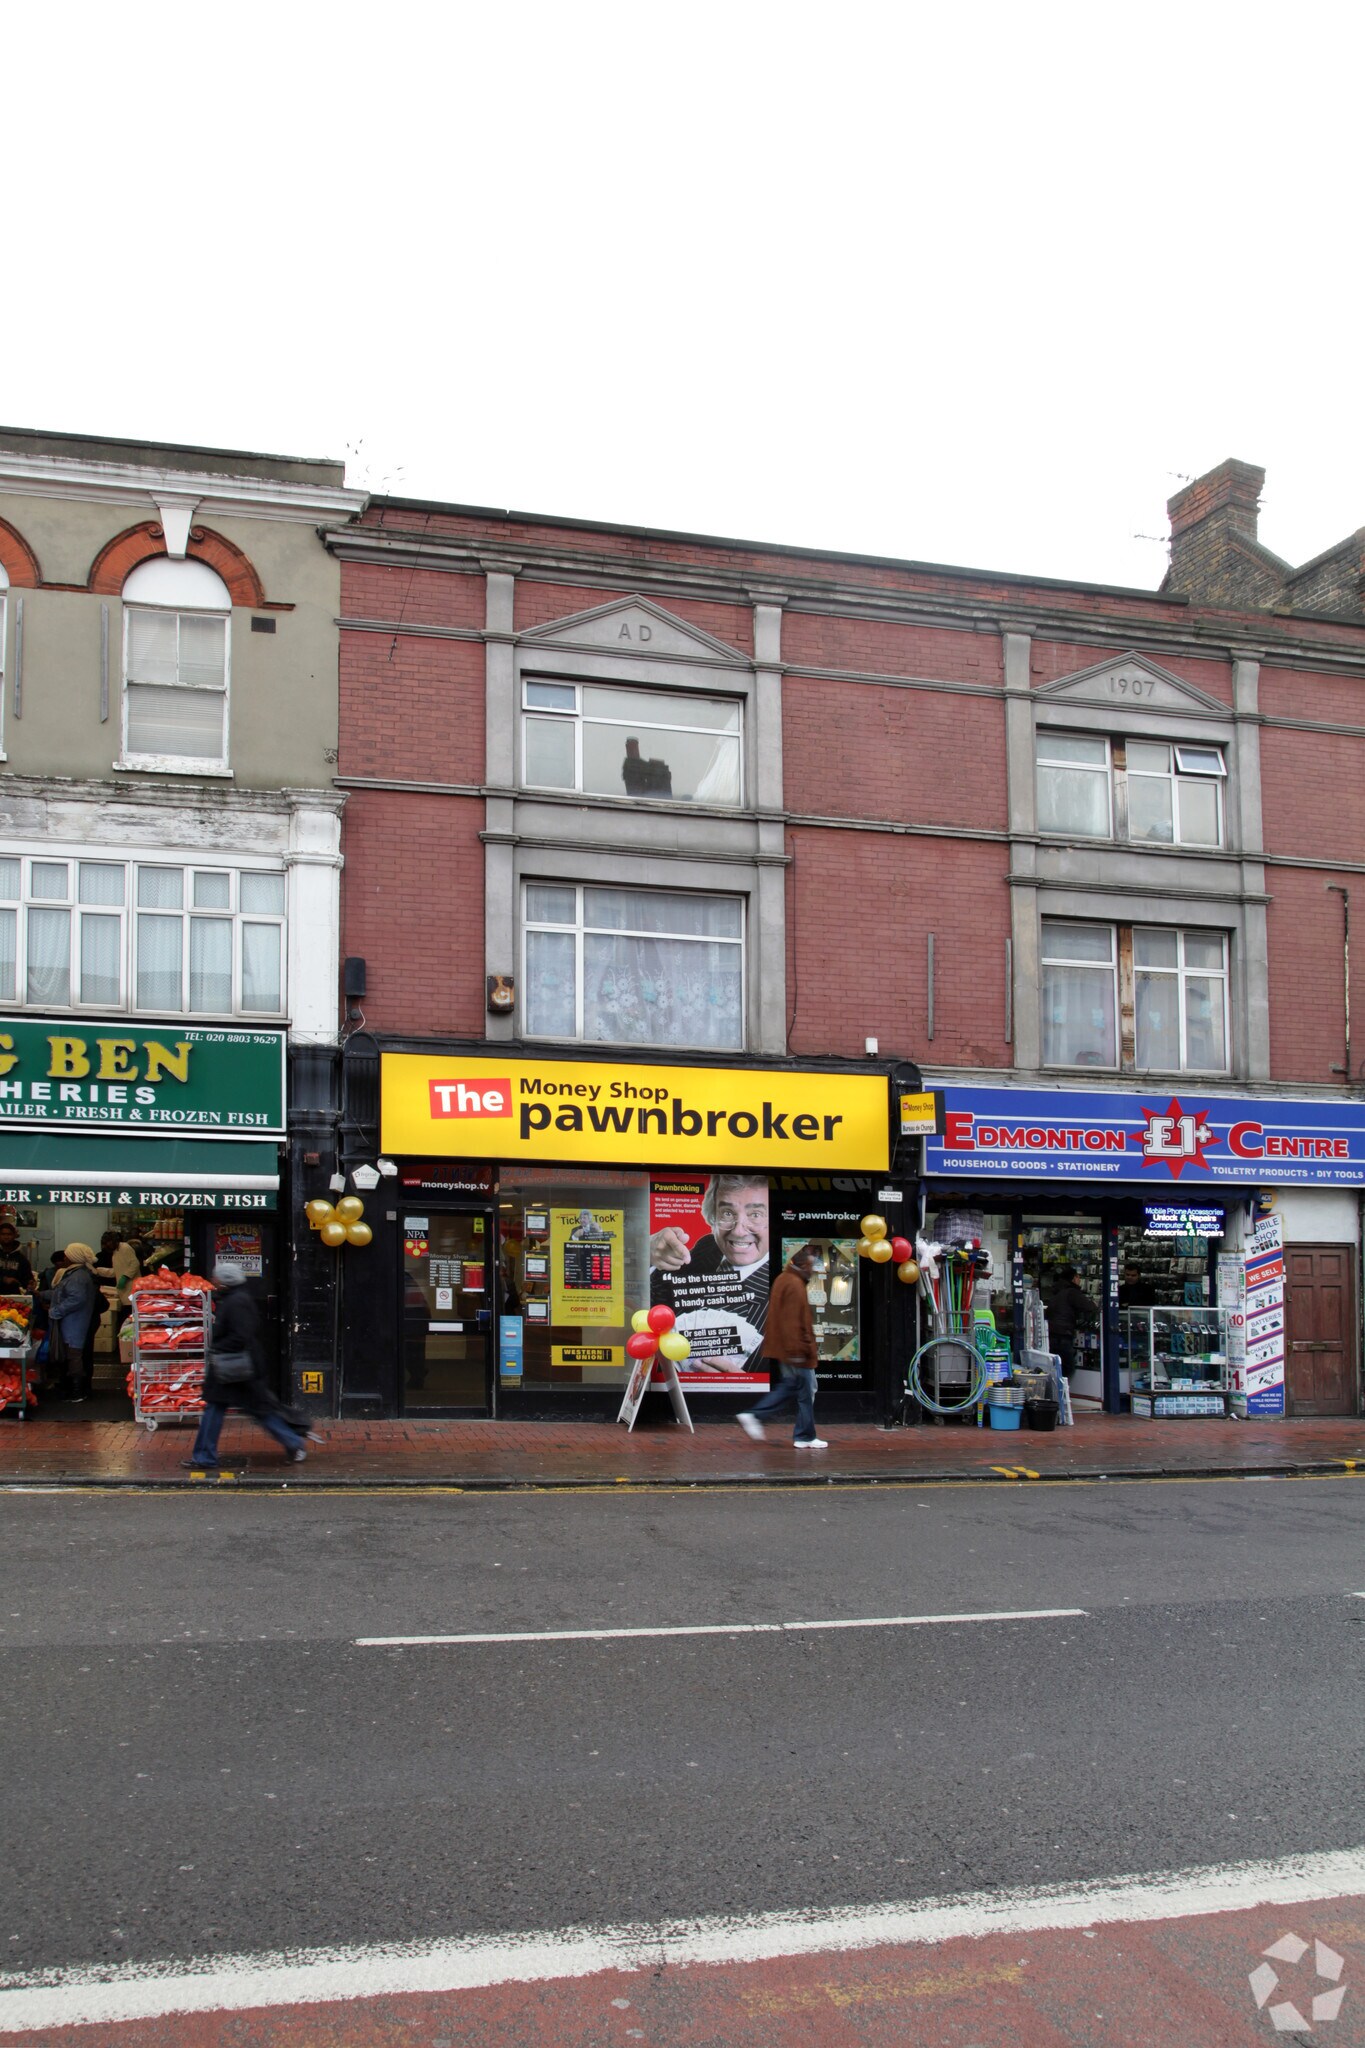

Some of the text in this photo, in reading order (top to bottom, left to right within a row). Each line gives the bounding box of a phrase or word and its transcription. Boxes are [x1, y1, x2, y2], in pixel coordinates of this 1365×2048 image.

[1110, 677, 1155, 696] 1907
[185, 1032, 277, 1044] TEL: 020 8803 9629
[46, 1036, 193, 1082] BEN
[434, 1083, 504, 1112] The
[520, 1078, 669, 1104] Money Shop
[65, 1106, 123, 1119] FRESH
[129, 1108, 143, 1120] &
[149, 1109, 221, 1123] FROZEN
[227, 1112, 268, 1125] FISH
[519, 1098, 843, 1141] pawnbroker
[943, 1112, 1126, 1151] EDMONTON
[1228, 1121, 1349, 1158] CENTRE
[943, 1159, 1121, 1172] HOUSEHOLD GOODS STATIONERY
[1212, 1166, 1364, 1179] TOILETRY PRODUCTS DIY TOOLS
[421, 1181, 489, 1191] moneyshop.tv
[654, 1183, 700, 1193] Pawnbroking
[49, 1190, 111, 1204] FRESH
[117, 1192, 133, 1204] &
[139, 1192, 217, 1207] FROZEN
[222, 1194, 267, 1207] FISH
[799, 1211, 860, 1220] pawnbroker
[1189, 1214, 1217, 1222] Repairs
[218, 1224, 258, 1236] CIRCUS
[1195, 1222, 1220, 1230] Laptop
[1254, 1217, 1280, 1232] OBILE
[407, 1230, 426, 1239] NPA
[1196, 1229, 1224, 1237] Repairs
[1254, 1229, 1278, 1244] SHOP
[688, 1274, 700, 1282] the
[702, 1273, 738, 1282] treasures
[1248, 1267, 1279, 1282] WE SELL
[673, 1288, 687, 1297] you
[717, 1284, 742, 1292] secure
[682, 1298, 705, 1307] handy
[706, 1296, 725, 1305] cash
[1251, 1312, 1282, 1328] BATTERIES
[693, 1329, 706, 1337] sell
[717, 1328, 731, 1336] any
[689, 1336, 730, 1347] damaged or
[689, 1346, 738, 1357] nwanted gold
